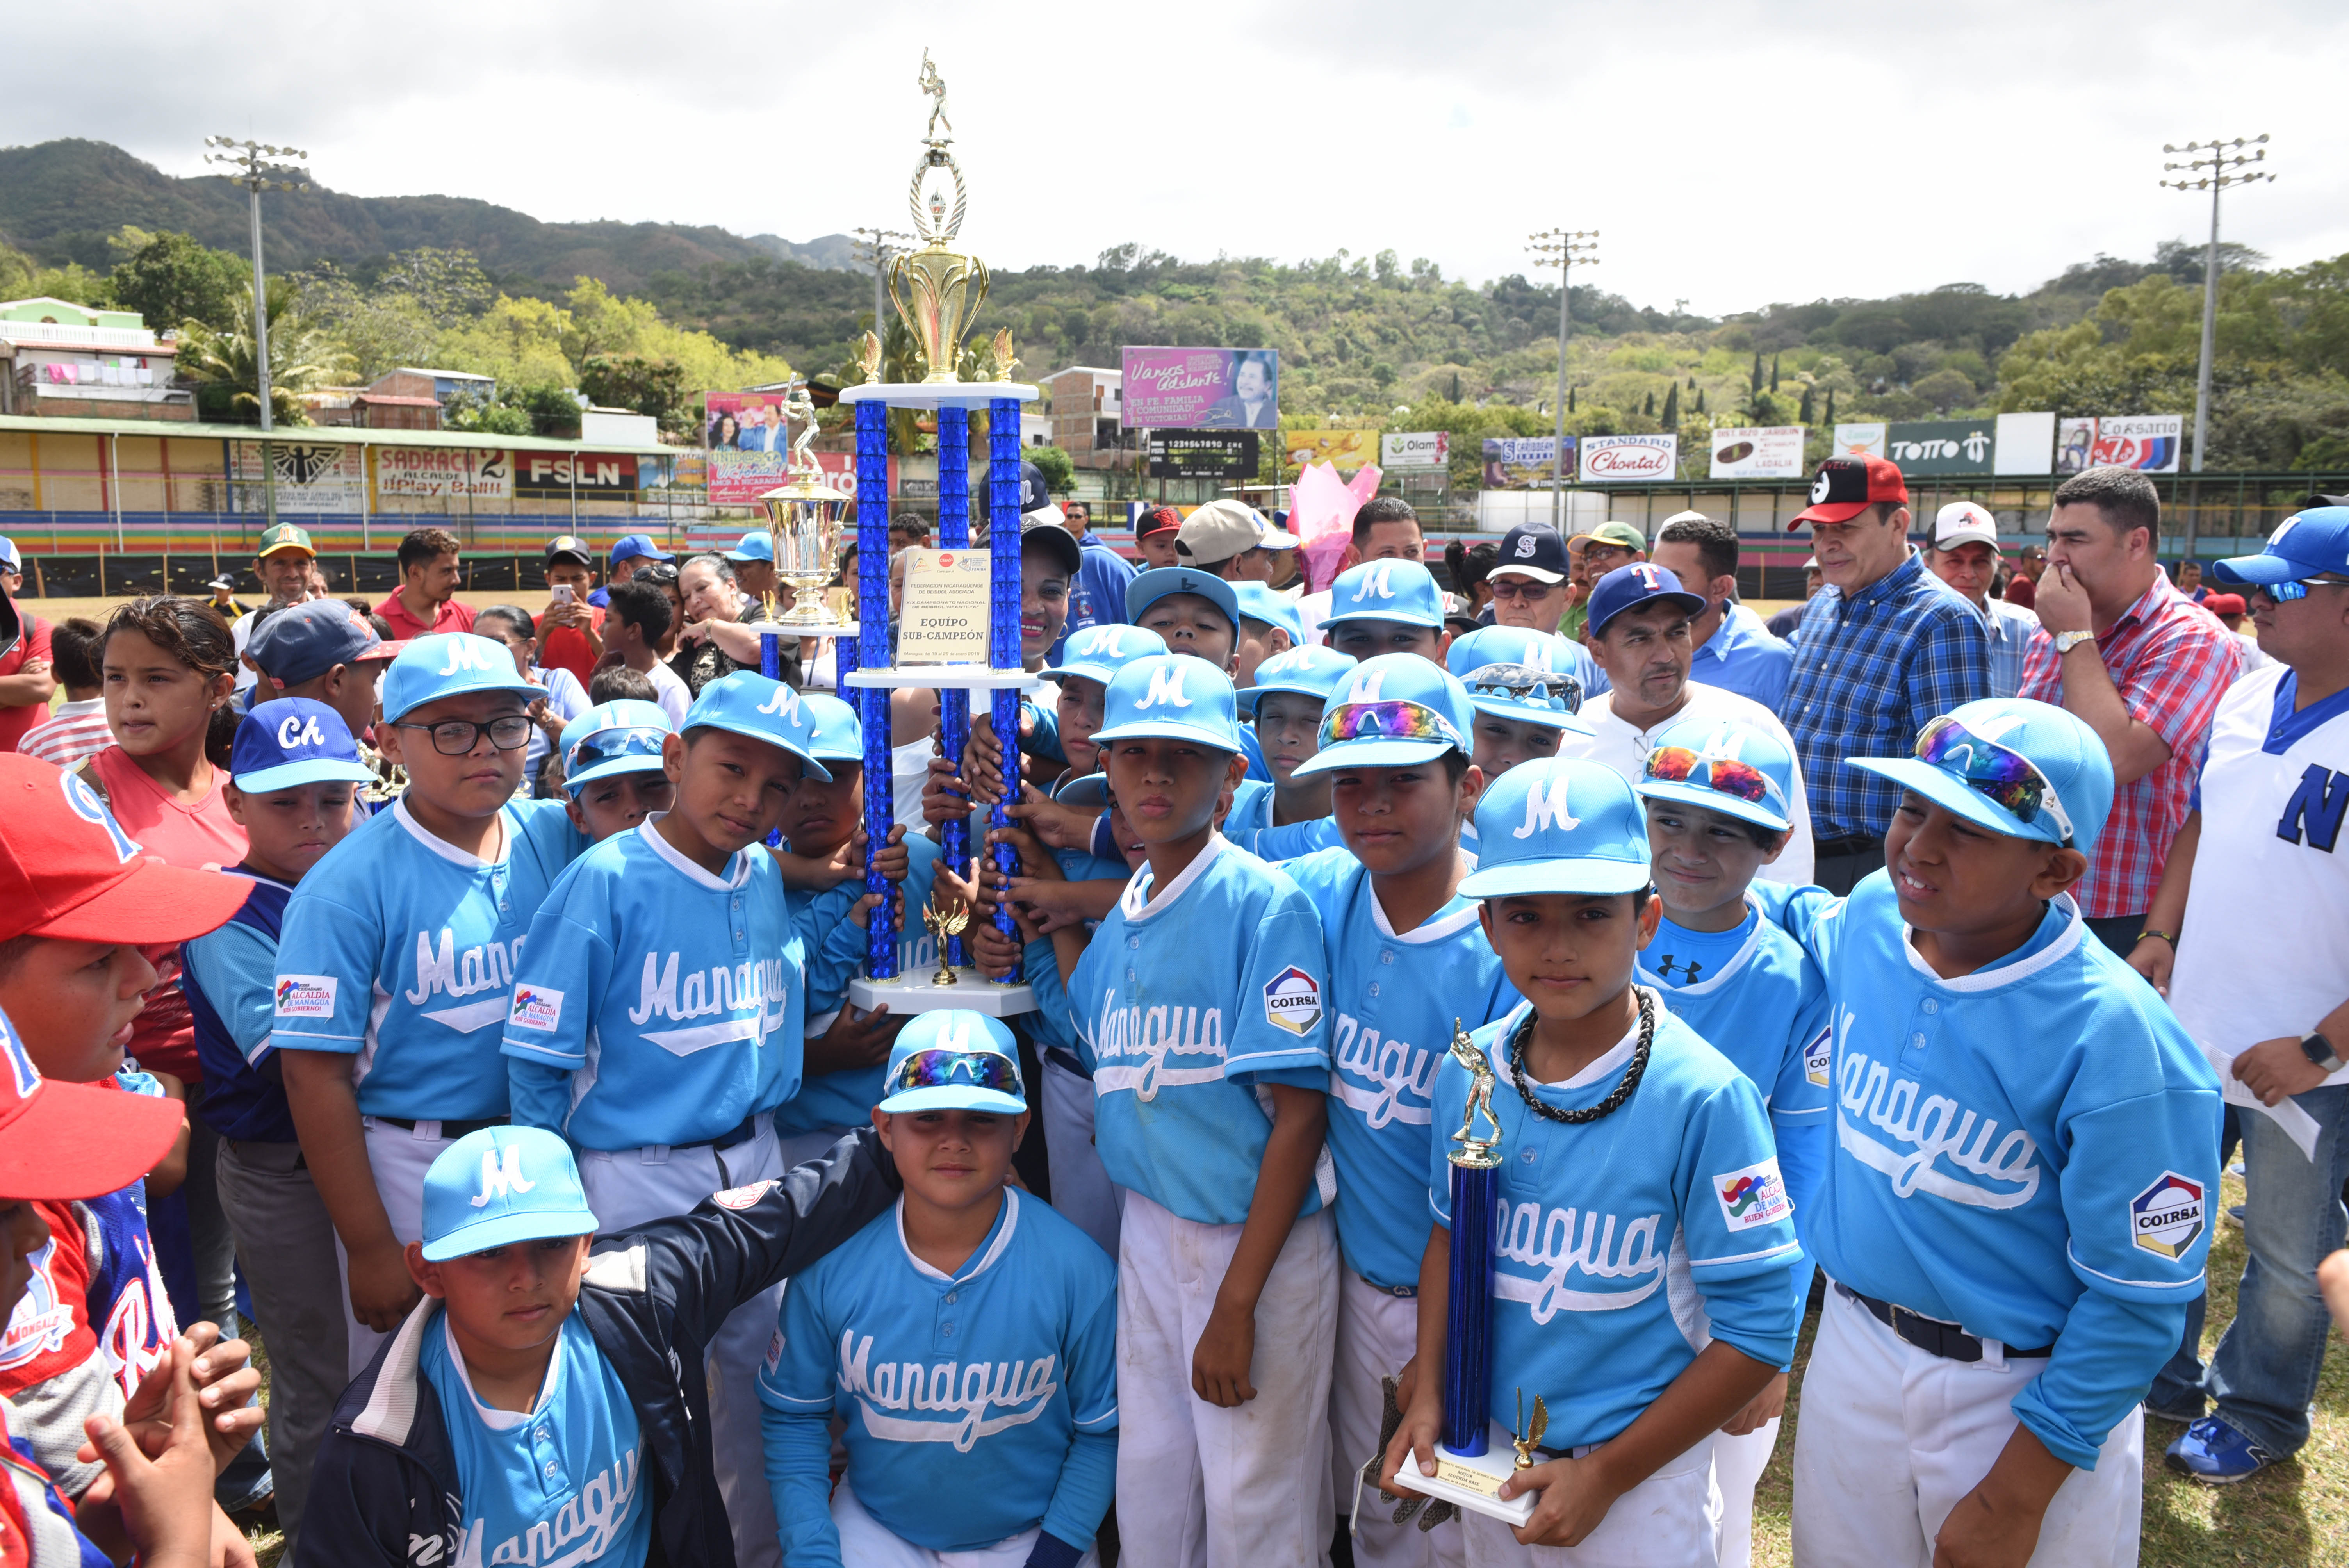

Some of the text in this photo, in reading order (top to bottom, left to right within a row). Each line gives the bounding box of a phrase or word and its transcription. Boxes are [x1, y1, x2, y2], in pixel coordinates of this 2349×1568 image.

[1126, 404, 1194, 415] Y COMUNIDAD!
[1164, 395, 1204, 404] FAMILIA
[1407, 440, 1435, 450] Olam
[1586, 436, 1672, 450] STANDARD
[1891, 439, 1959, 460] TOTTO
[381, 449, 475, 472] SADRACH
[480, 449, 505, 478] 2
[531, 458, 620, 486] FSLN
[1592, 451, 1665, 472] Chontal
[403, 471, 461, 480] ALCALDE
[1515, 535, 1536, 558] S
[1351, 566, 1395, 603] M
[1630, 563, 1660, 590] T
[920, 616, 968, 628] EQUÍPO
[903, 629, 984, 640] SUB-CAMPEÓN
[1080, 627, 1125, 658] M
[439, 638, 494, 676] M
[1271, 651, 1316, 674] M
[1134, 665, 1193, 711] M
[756, 685, 802, 727] M
[278, 715, 324, 750] Ch
[1512, 775, 1581, 839] M
[292, 990, 330, 1000] ALCALDÍA
[1270, 994, 1318, 1009] COIRSA
[528, 1005, 556, 1017] ALCALDÍA
[528, 1012, 554, 1023] MANAGUA
[523, 1017, 547, 1027] GOBIERNO!
[471, 1144, 536, 1208] M
[1755, 1201, 1767, 1212] DE
[1744, 1212, 1764, 1223] BUEN
[2138, 1206, 2200, 1229] COIRSA
[837, 1329, 1057, 1453] Managua
[1447, 1473, 1468, 1482] SEGUNDA
